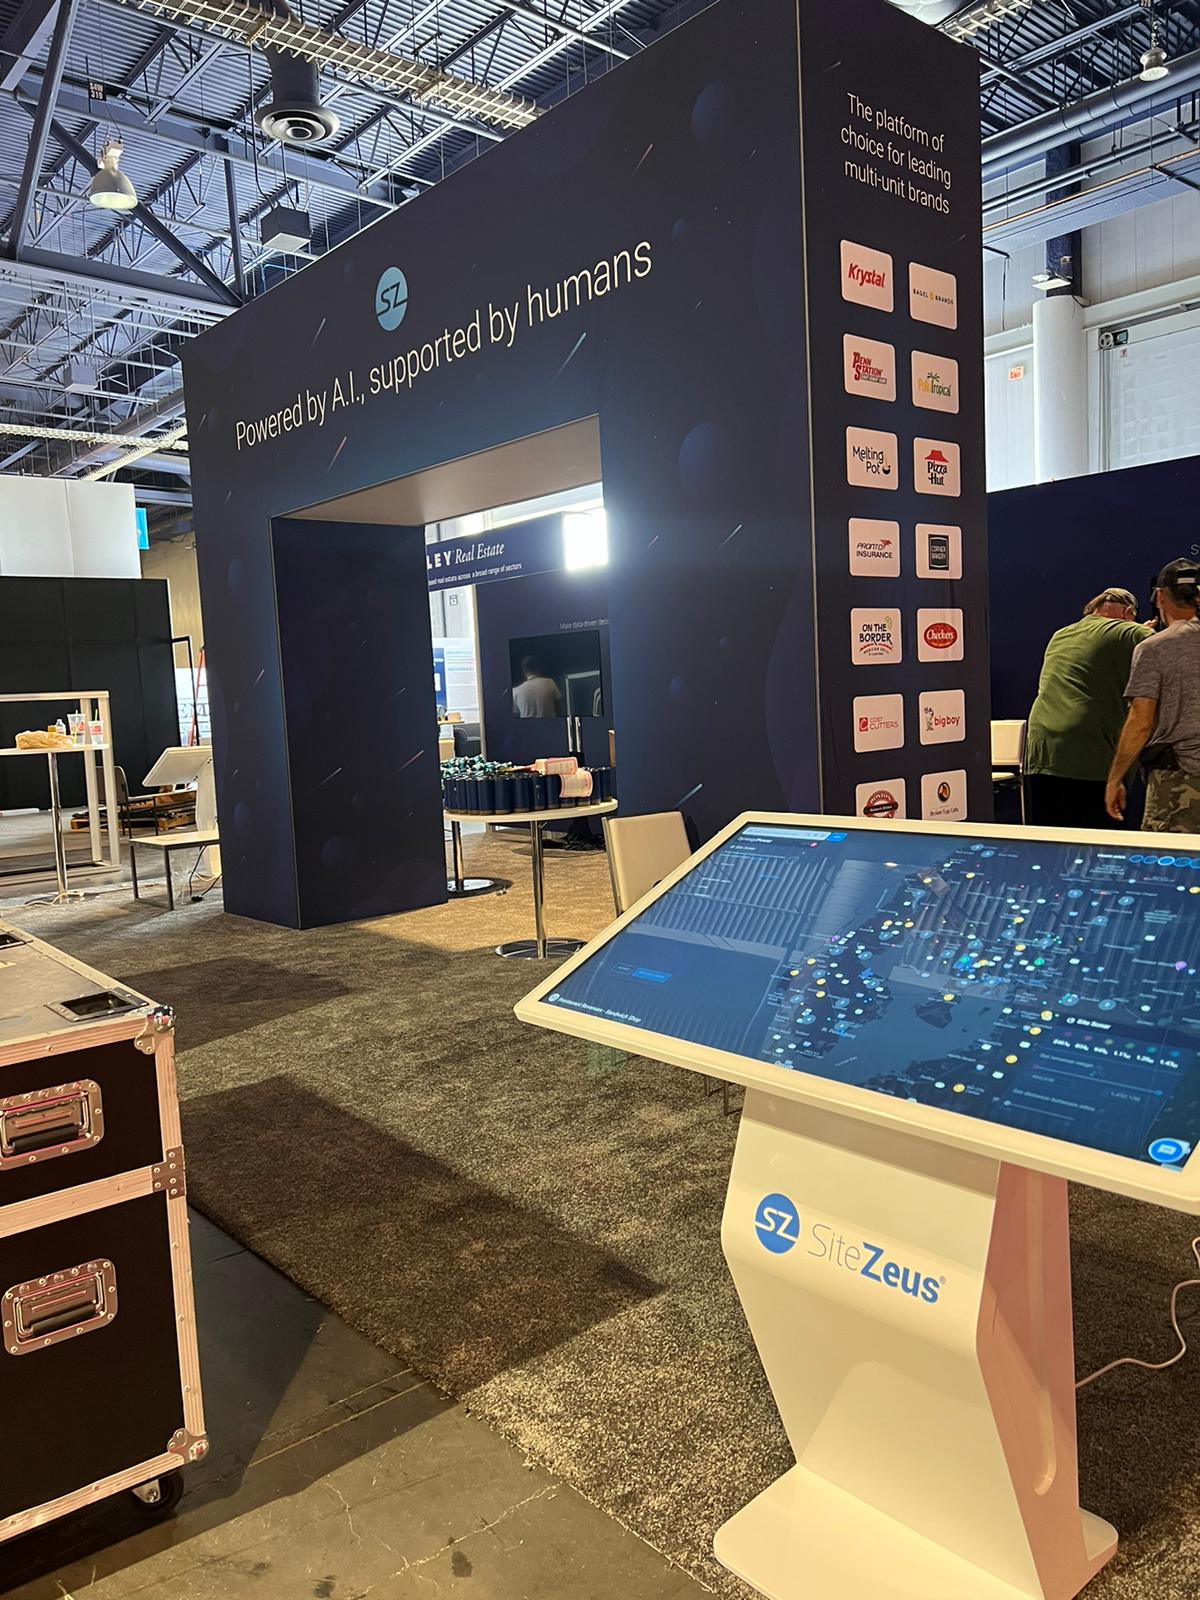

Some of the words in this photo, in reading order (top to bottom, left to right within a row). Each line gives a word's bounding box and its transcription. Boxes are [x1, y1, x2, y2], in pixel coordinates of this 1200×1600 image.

[847, 92, 873, 122] The
[876, 108, 929, 147] platform
[932, 134, 945, 153] of
[841, 125, 884, 158] choice
[887, 142, 905, 165] for
[908, 150, 951, 190] leading
[845, 159, 906, 199] multi-unit
[909, 181, 950, 214] brands
[848, 263, 886, 288] Krystal
[913, 288, 929, 299] BAGEL
[935, 294, 954, 306] BRANDS
[236, 394, 303, 450] Powered
[306, 390, 326, 426] by
[332, 371, 366, 411] A.I.,
[369, 310, 481, 394] supported
[490, 302, 519, 348] by
[527, 241, 652, 327] humans
[853, 446, 884, 463] Melting
[866, 460, 880, 475] Pot
[927, 461, 948, 475] Pizza
[928, 473, 945, 486] Hut
[455, 544, 475, 564] Real
[476, 543, 505, 560] Estate
[856, 551, 893, 559] INSURANCE
[1190, 544, 1200, 556] S
[862, 624, 873, 632] ON
[874, 624, 887, 632] THE
[859, 633, 893, 645] BORDER
[807, 1223, 940, 1303] SiteZeus
